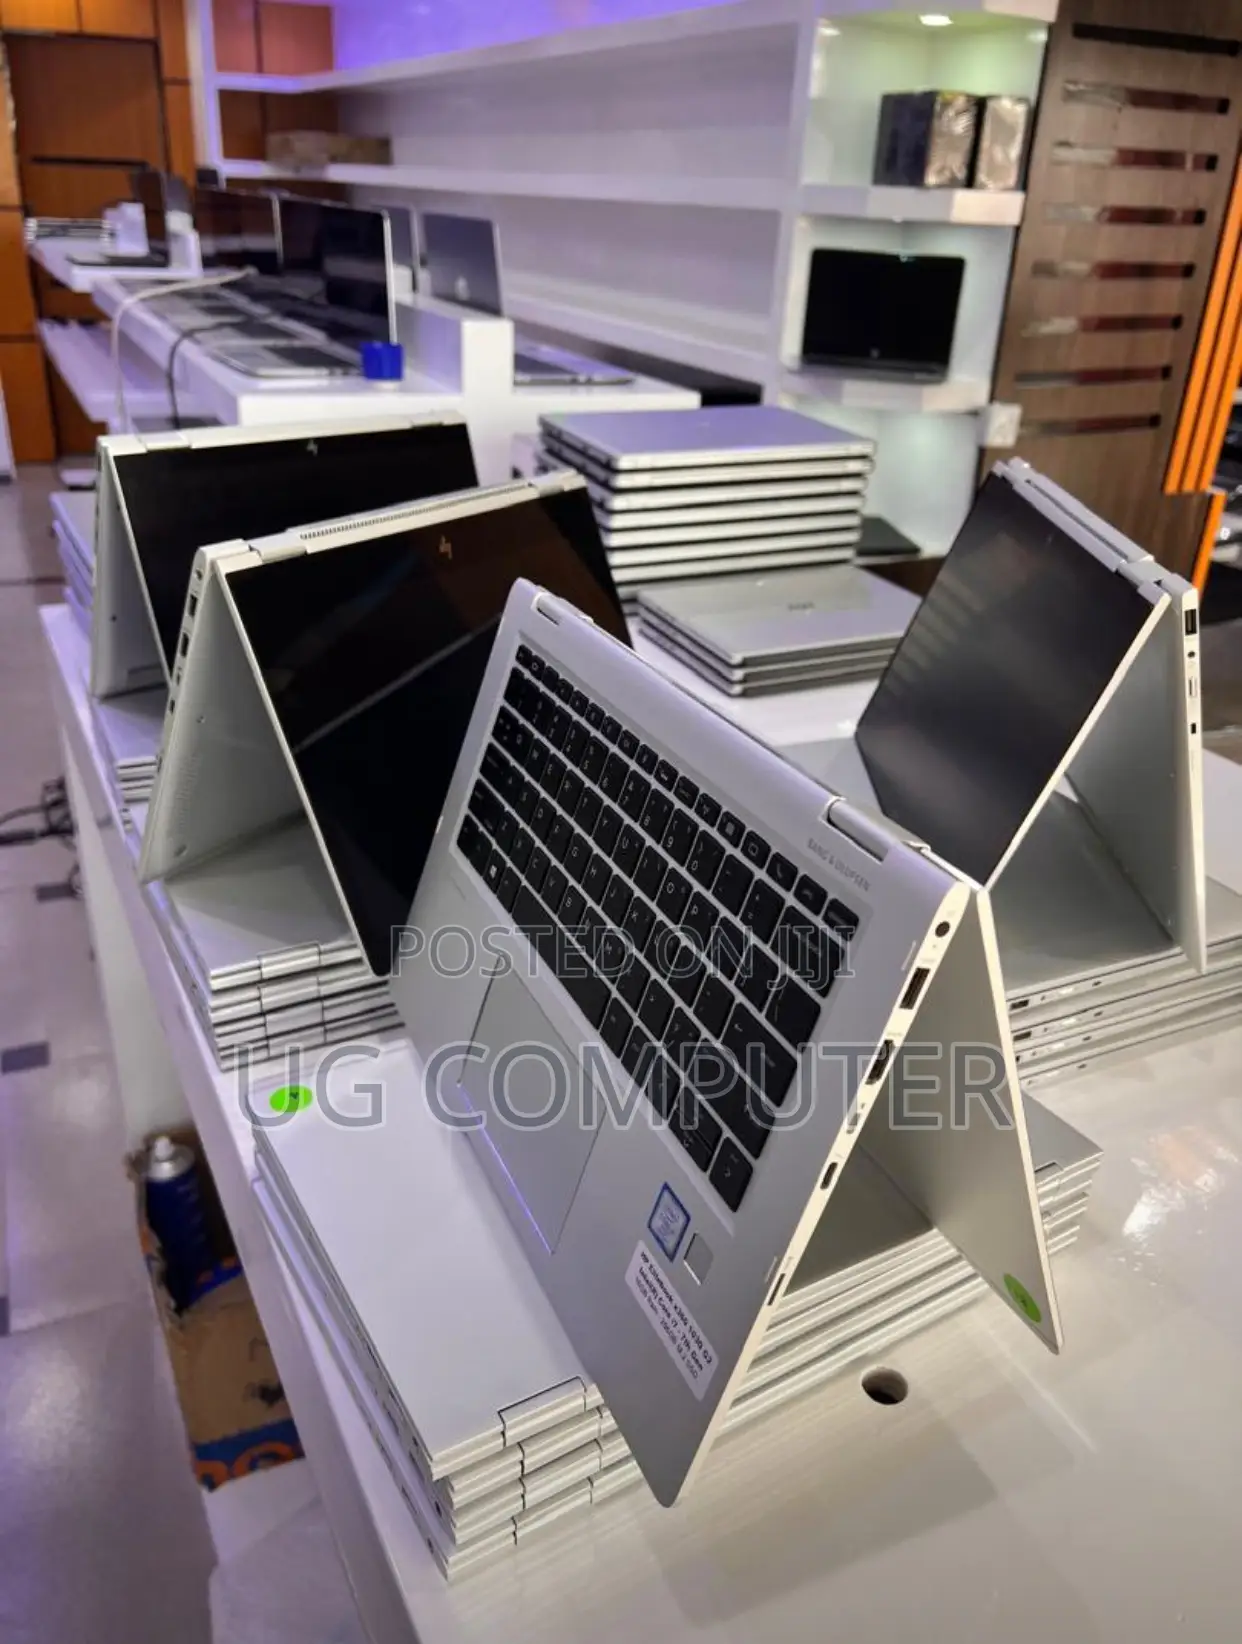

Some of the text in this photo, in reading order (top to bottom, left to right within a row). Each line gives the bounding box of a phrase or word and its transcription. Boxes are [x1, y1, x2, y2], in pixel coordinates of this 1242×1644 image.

[687, 1323, 703, 1351] 1030
[701, 1346, 713, 1367] G2
[690, 1348, 704, 1372] Gen
